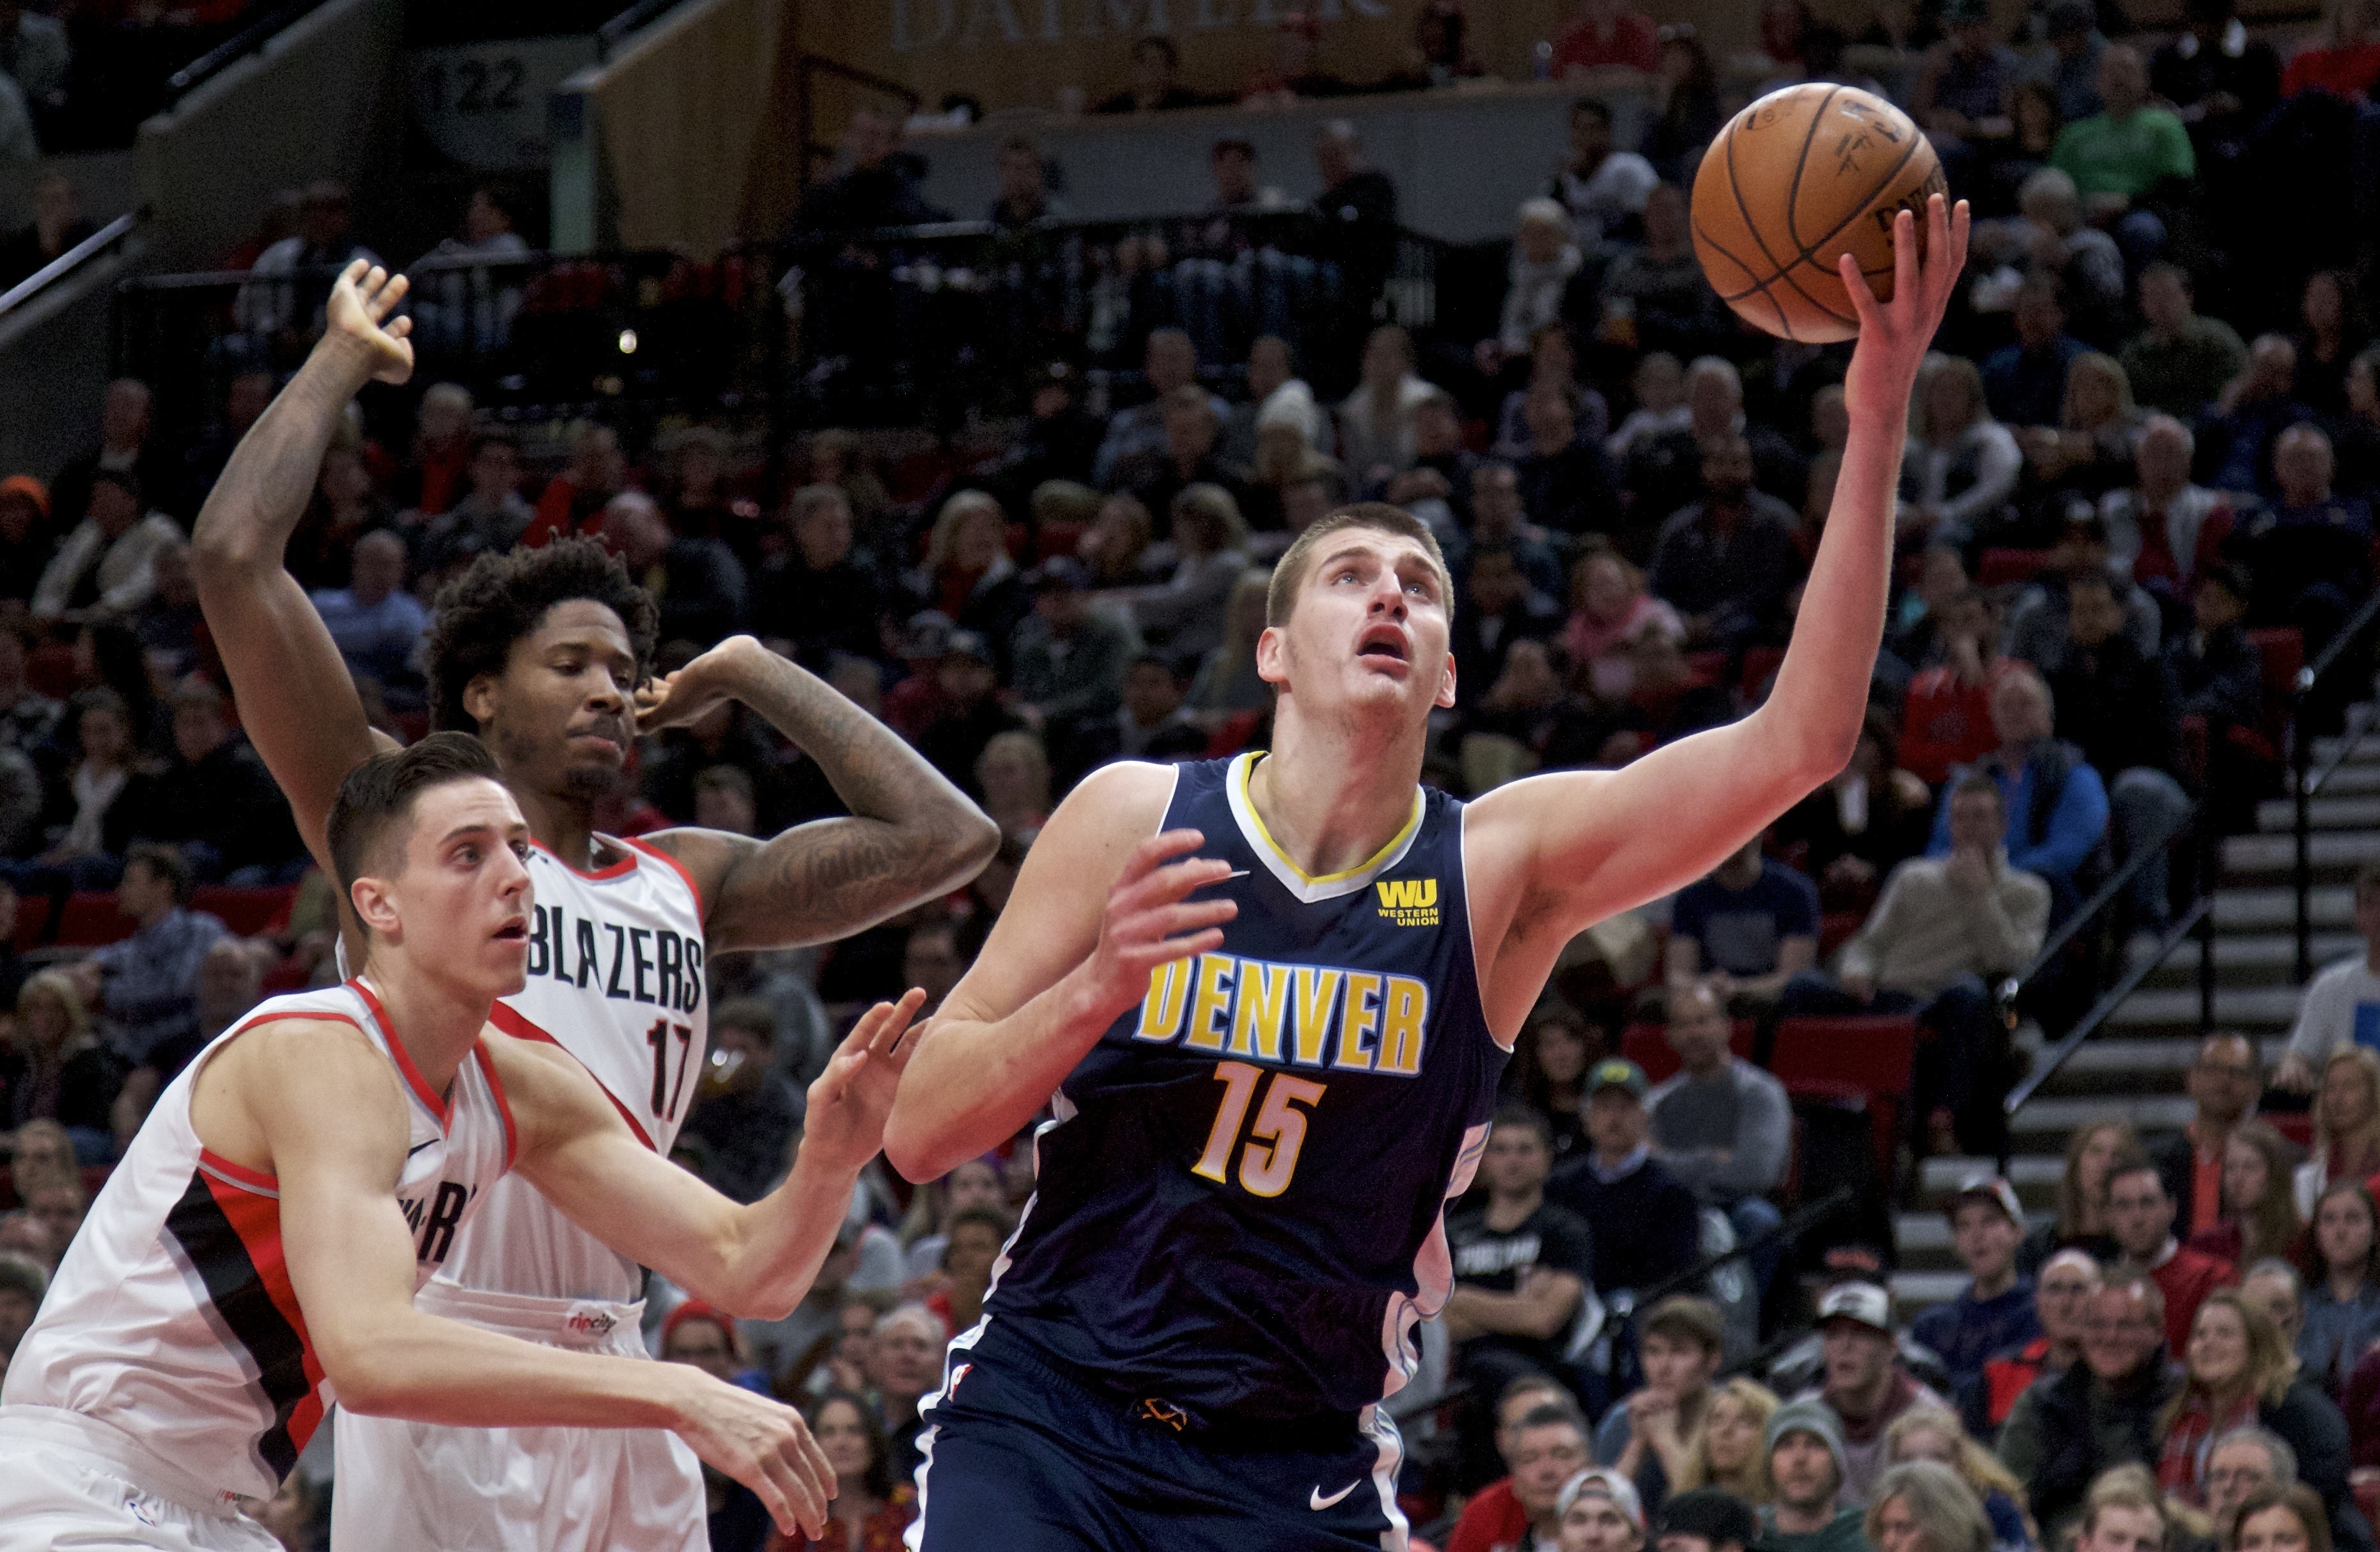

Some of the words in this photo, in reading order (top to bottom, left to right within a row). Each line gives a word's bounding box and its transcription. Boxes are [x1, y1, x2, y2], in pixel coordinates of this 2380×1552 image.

[428, 57, 525, 114] 122
[1376, 878, 1437, 908] WU
[1378, 908, 1438, 918] WESTERN
[1397, 916, 1439, 927] UNION
[528, 904, 703, 1014] BLAZERS
[1132, 950, 1431, 1078] DENVER
[646, 1018, 692, 1123] 17
[1191, 1060, 1328, 1198] 15
